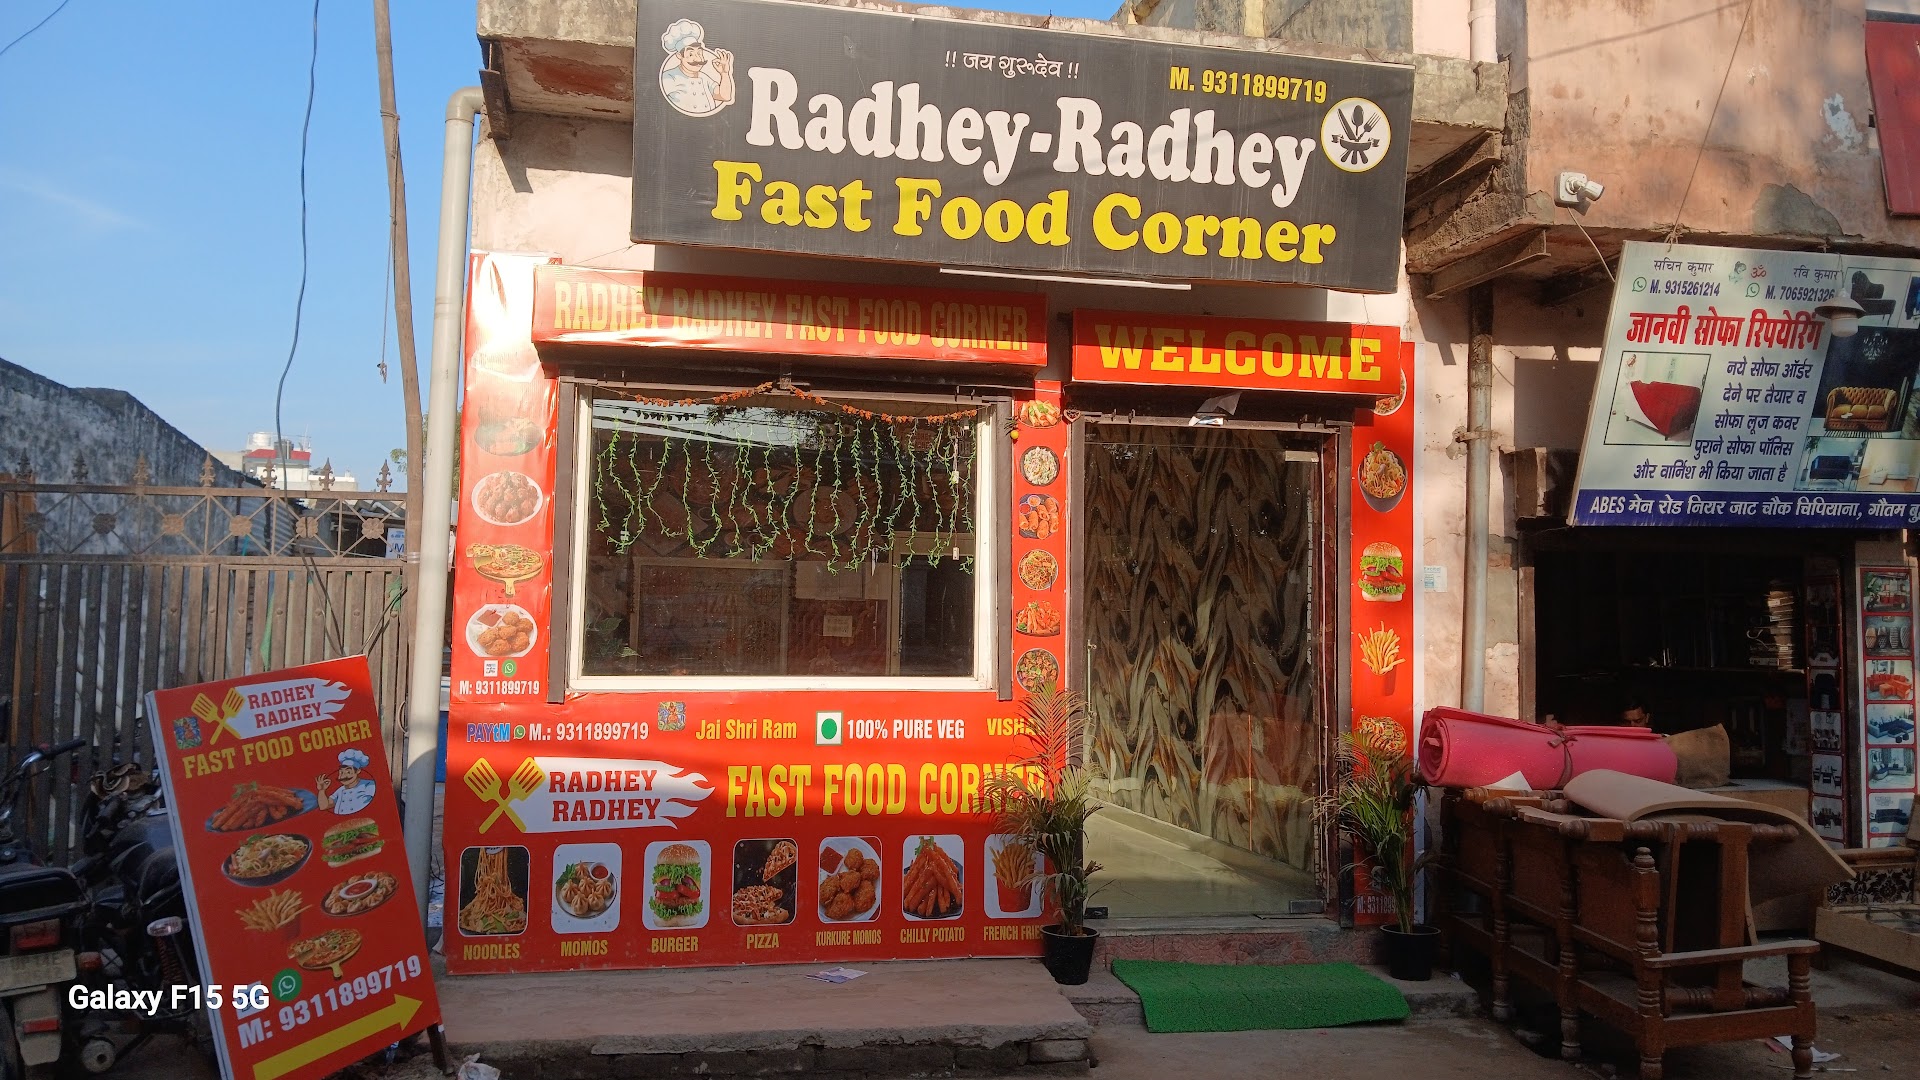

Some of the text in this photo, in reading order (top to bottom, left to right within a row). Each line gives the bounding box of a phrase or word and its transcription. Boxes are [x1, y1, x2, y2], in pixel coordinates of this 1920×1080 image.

[963, 52, 996, 71] जय
[1169, 66, 1327, 104] M. 9311899719
[745, 65, 1317, 210] Radhey-Radhey
[711, 159, 1337, 265] Fast Food Corner
[1653, 257, 1715, 277] सचिन कुमार
[1793, 264, 1840, 284] रवि कुमार
[1649, 279, 1721, 297] M. 9315261214
[1765, 285, 1835, 302] M. 7065921326
[554, 280, 1028, 351] RADHEY RADHEY FAST FOOD CORNER
[1626, 304, 1692, 345] जानवी
[1694, 305, 1746, 347] सोफा
[1094, 324, 1382, 382] WELCOME
[1726, 355, 1814, 379] नये सोफा ऑर्डर
[1722, 382, 1808, 405] देने पर तैयार व
[1714, 408, 1801, 435] सोफा लूज कवर
[1694, 434, 1795, 460] पुराने सोफा पॉलिस
[1633, 458, 1790, 483] और वार्निश भी किया जाता है
[1590, 496, 1626, 514] ABES
[1628, 493, 1655, 514] मेन
[1658, 494, 1684, 514] रोड
[1686, 494, 1726, 515] नियर
[1729, 500, 1758, 515] जाट
[1761, 496, 1794, 516] चौक
[1867, 497, 1907, 517] गौतम
[459, 680, 540, 695] M: 9311899719
[247, 684, 322, 729] RADHEY RADHEY
[556, 722, 649, 741] 9311899719
[695, 719, 797, 741] Jai Shri Ram
[846, 719, 965, 739] 100% PURE VEG
[182, 719, 372, 779] FAST FOOD CORNER
[549, 769, 661, 823] RADHEY RADHEY
[726, 765, 811, 818] FAST
[822, 763, 906, 817] FOOD
[651, 936, 699, 953] BURGER
[746, 932, 780, 949] PIZZA
[815, 929, 882, 946] KURKURE MOMOS
[900, 926, 965, 944] CHILLY POTATO
[983, 925, 1019, 941] FRENCH
[463, 943, 521, 961] NOODLES
[560, 940, 608, 957] MOMOS
[237, 954, 421, 1049] M: 9311899719
